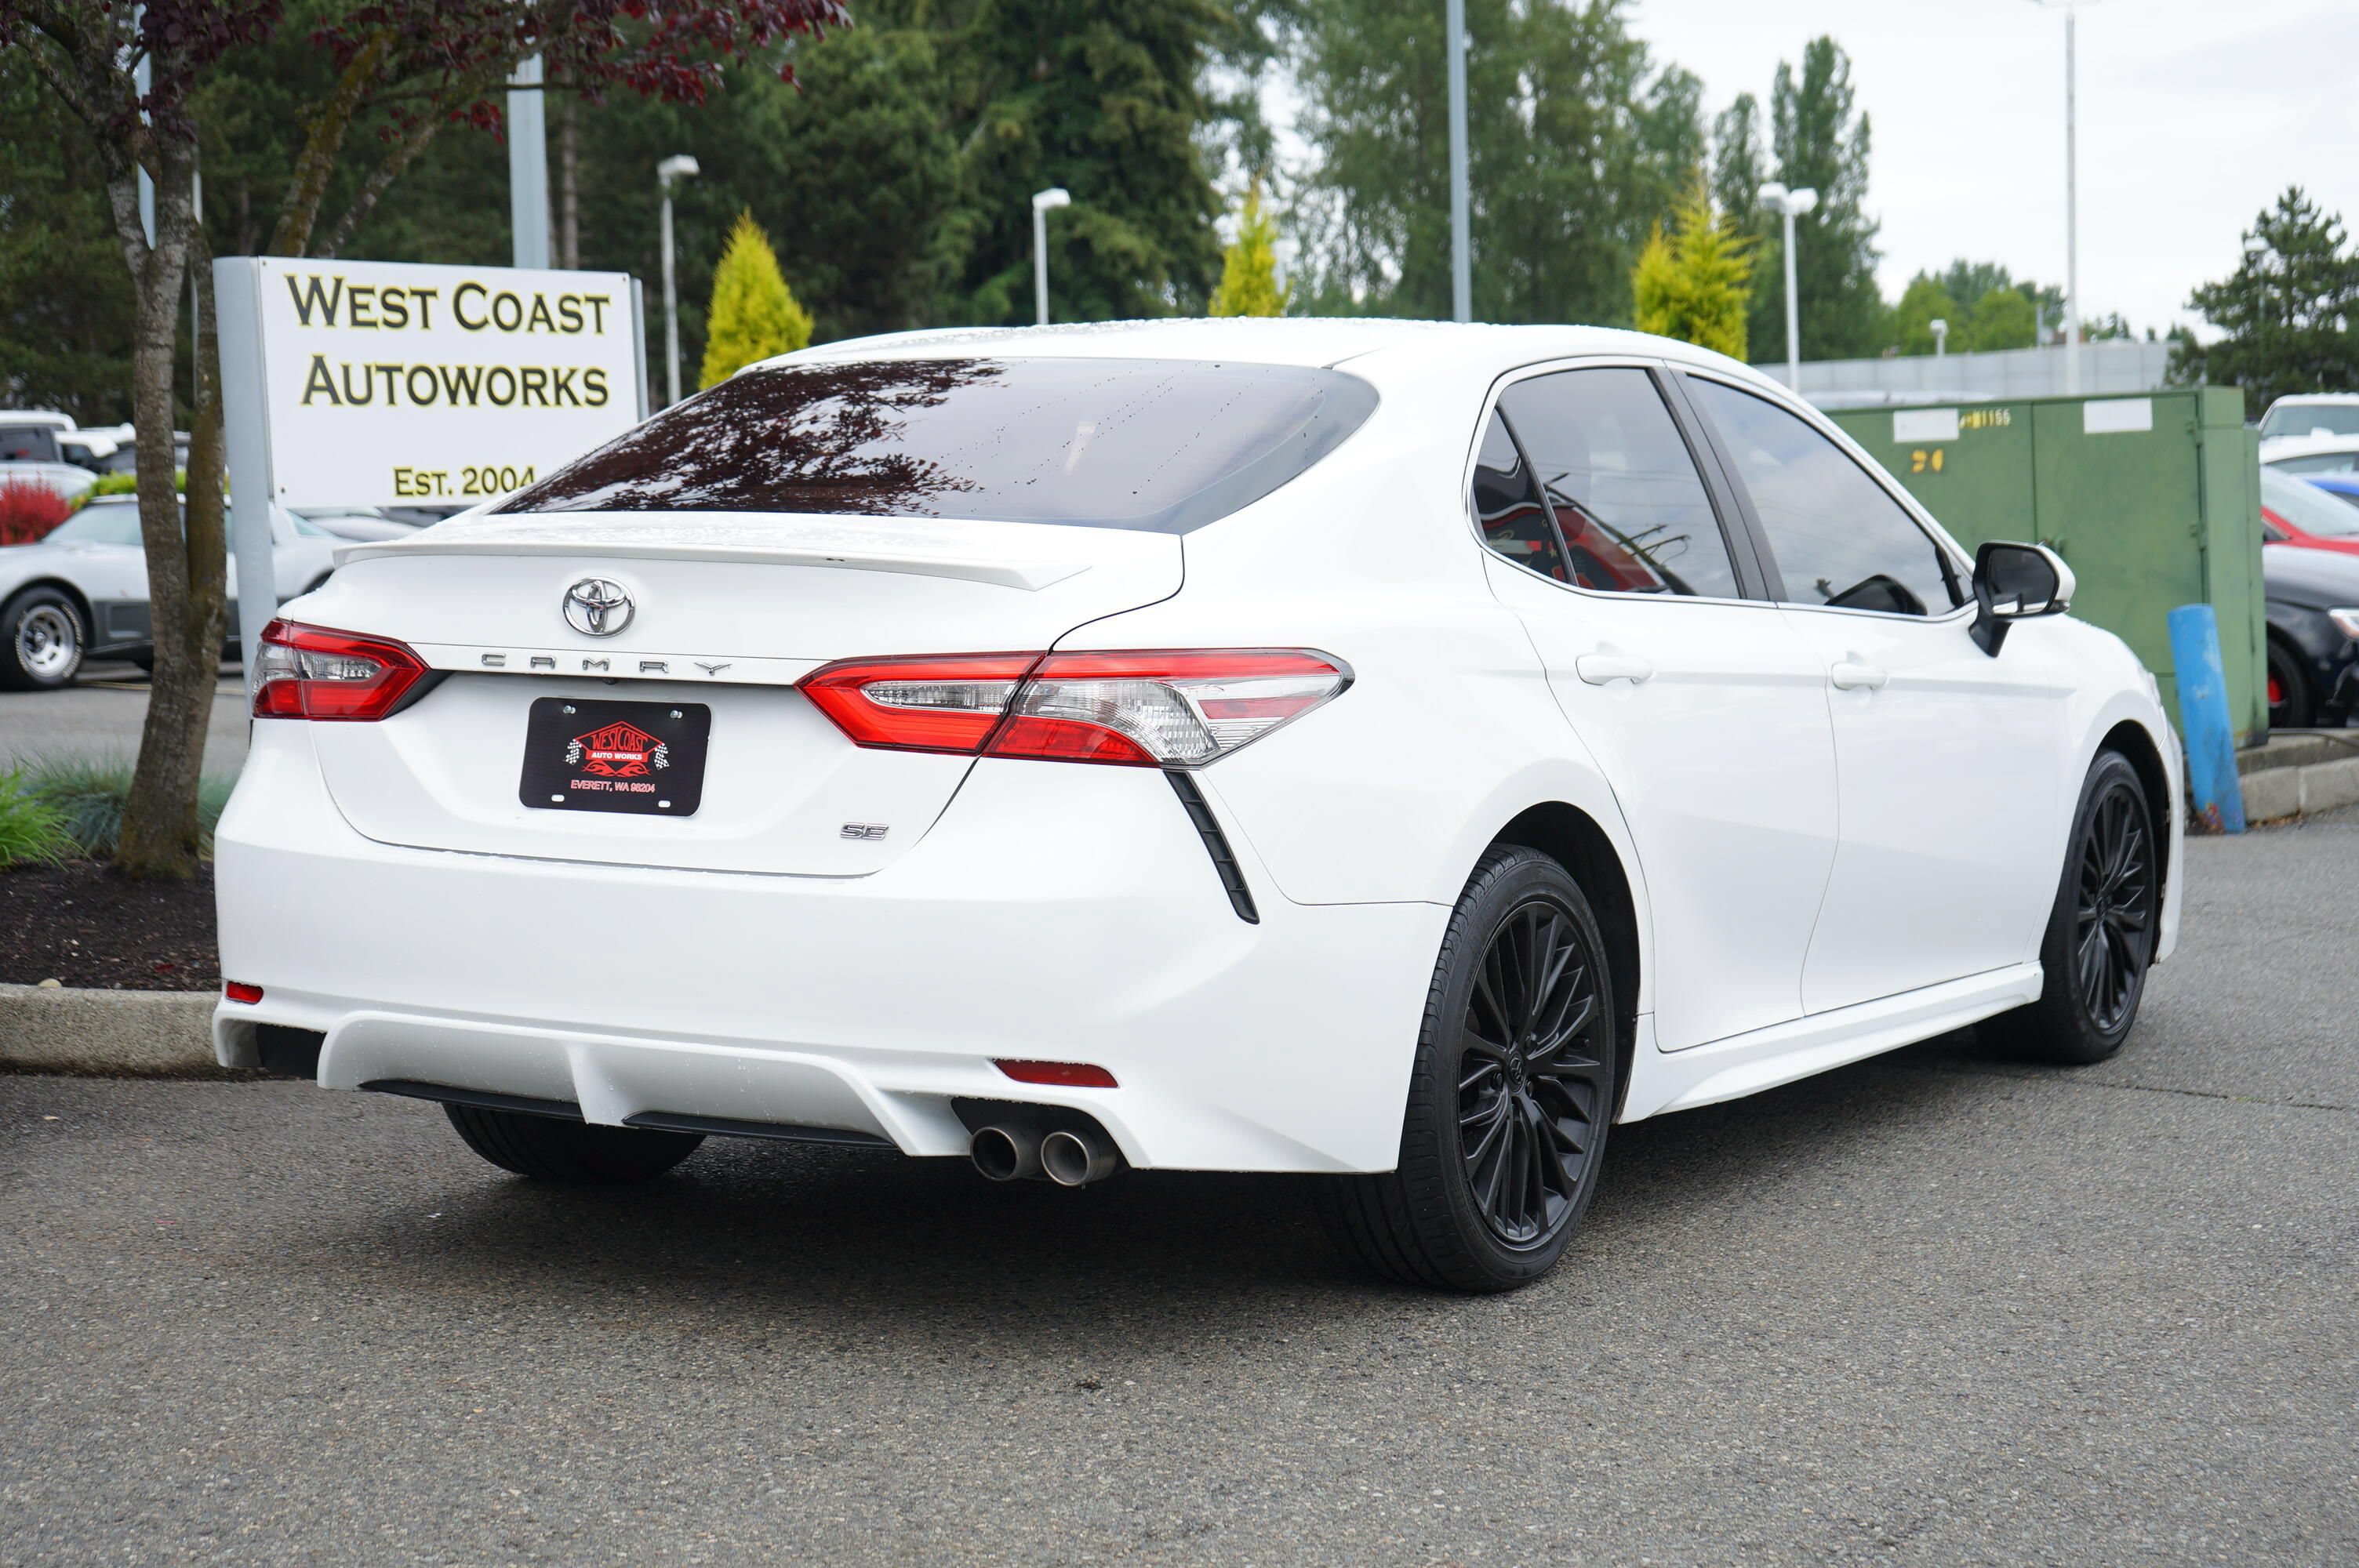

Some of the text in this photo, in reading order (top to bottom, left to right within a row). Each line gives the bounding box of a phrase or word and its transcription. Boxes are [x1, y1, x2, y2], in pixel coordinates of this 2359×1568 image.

[285, 274, 610, 335] WEST COAST
[300, 354, 609, 407] AUTOWORKS
[394, 466, 453, 497] EST.
[482, 652, 732, 676] CAMRY
[570, 779, 656, 793] EVERETT, WA 98204
[840, 822, 889, 840] SE
